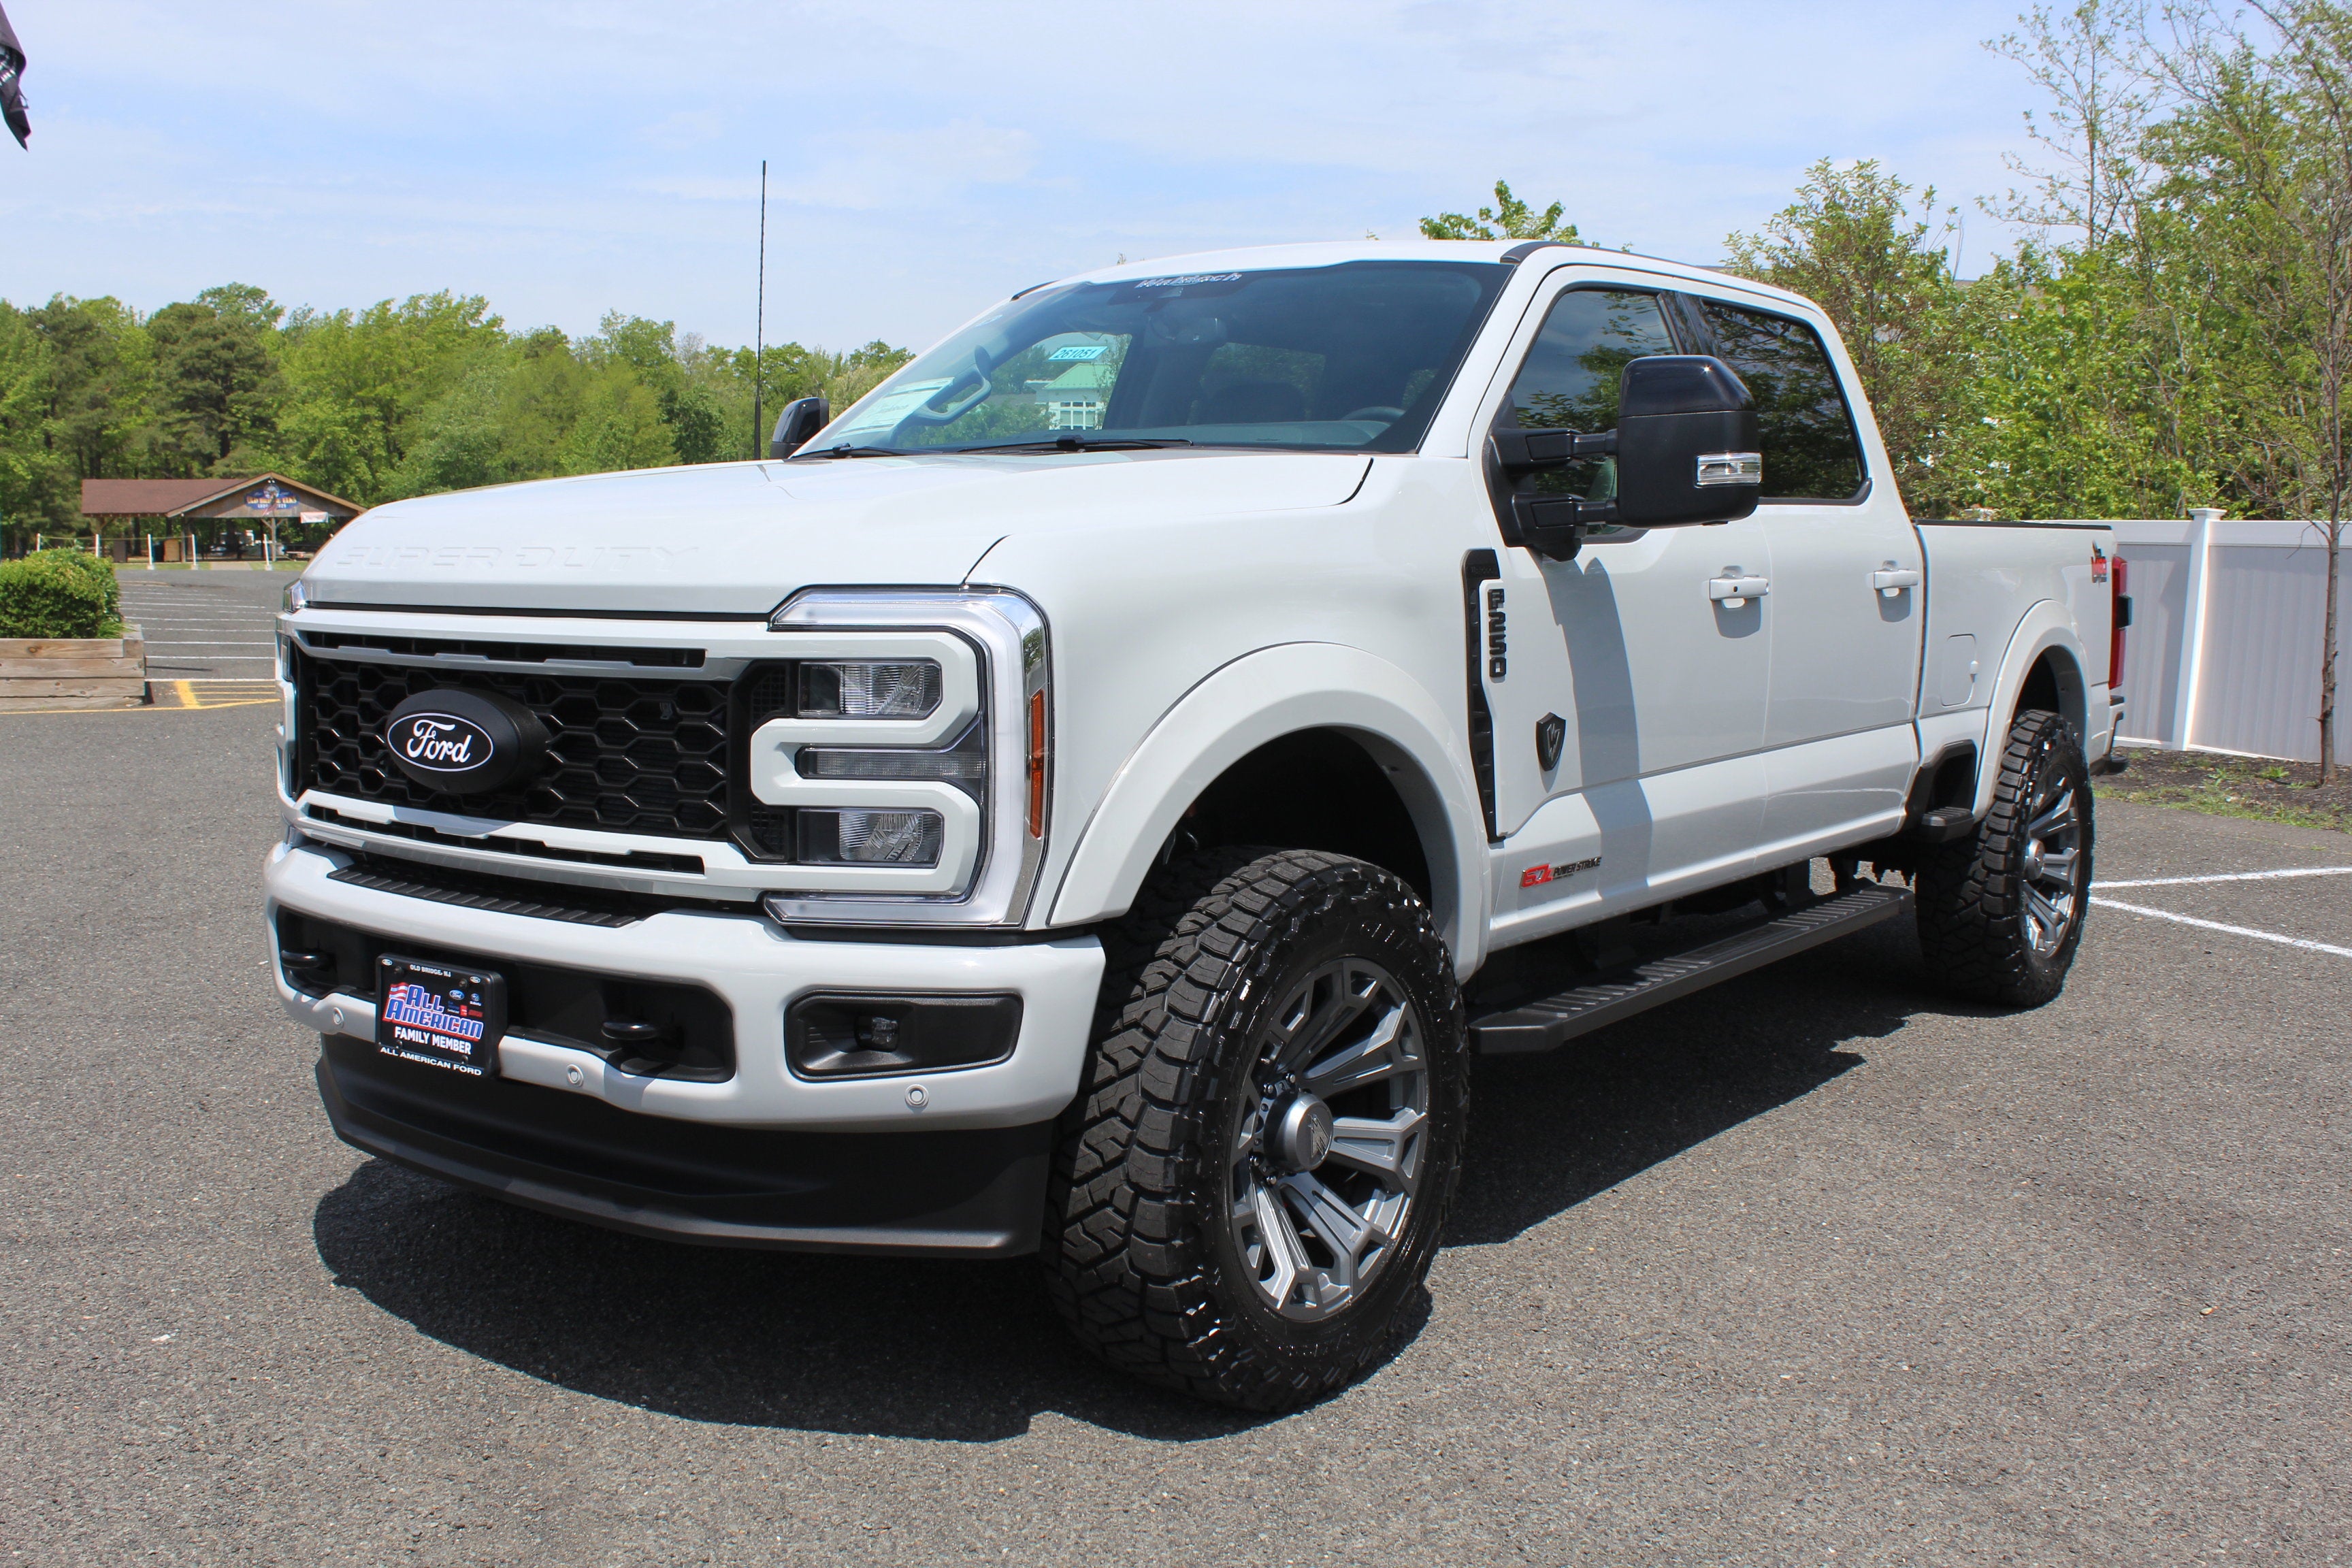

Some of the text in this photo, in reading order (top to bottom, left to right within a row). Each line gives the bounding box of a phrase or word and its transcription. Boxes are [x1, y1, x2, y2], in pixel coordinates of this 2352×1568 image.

[1053, 348, 1098, 359] 261051
[336, 546, 700, 572] SUPER DUTY
[1488, 589, 1507, 678] F250
[406, 719, 472, 763] Ford
[1553, 863, 1576, 877] POWER
[1575, 857, 1602, 871] STROKE
[410, 964, 420, 972] OLD
[406, 985, 444, 1013] ALL
[395, 1026, 472, 1055] FAMILY MEMBER
[380, 1047, 482, 1076] ALL AMERICAN FORD
